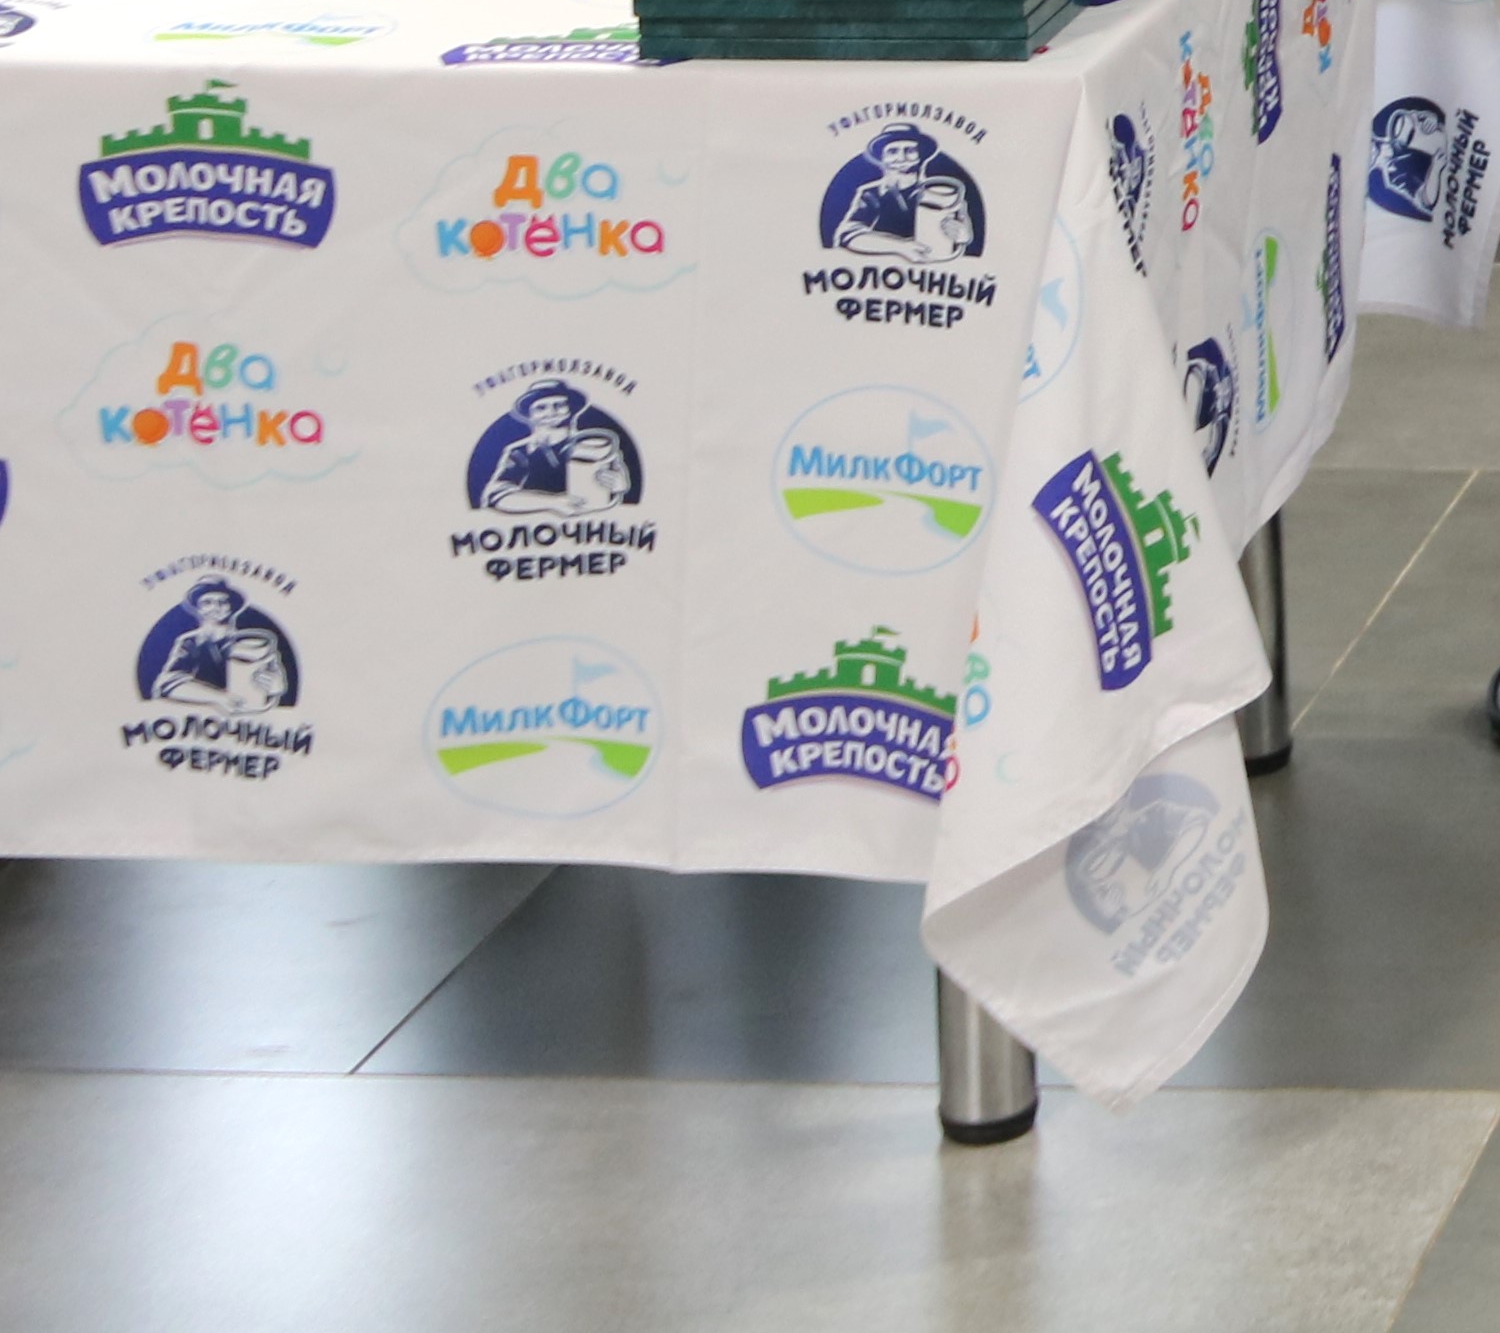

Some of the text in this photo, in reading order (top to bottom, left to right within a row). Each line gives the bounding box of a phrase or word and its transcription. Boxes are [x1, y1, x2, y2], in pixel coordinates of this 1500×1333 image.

[827, 101, 988, 146] УФАГОРМОЛЗАВОД
[492, 151, 619, 210] Два
[1457, 138, 1492, 237] ФЕРМЕР
[108, 196, 308, 238] КРЕПОСТЬ
[802, 265, 998, 308] МОЛОЧНЫЙ
[835, 296, 965, 330] ФЕРМЕР
[156, 340, 277, 397] Два
[449, 518, 659, 558] МОЛОЧНЫЙ
[485, 550, 629, 583] ФЕРМЕР
[1050, 495, 1121, 674] КРЕПОСТЬ
[121, 714, 316, 756] МОЛОЧНЫЙ
[159, 746, 282, 781] ФЕРМЕР
[769, 739, 946, 794] КРЕПОСТЬ
